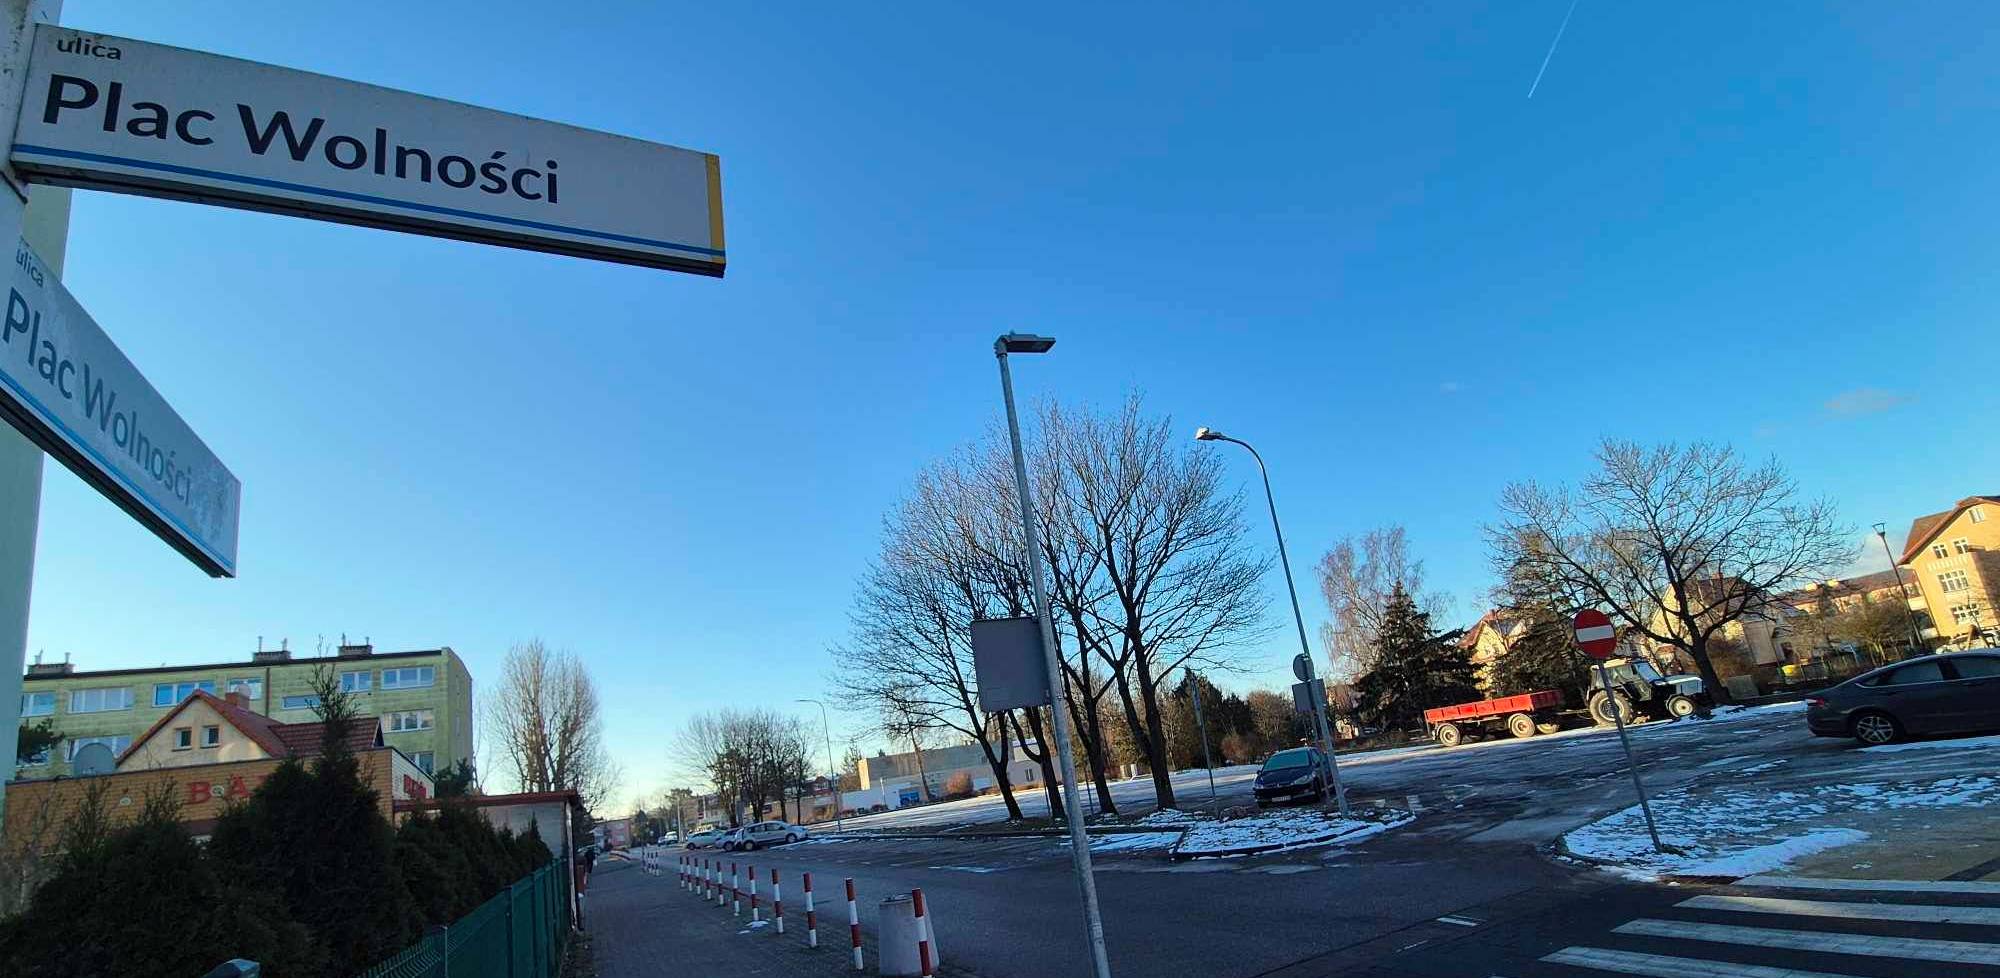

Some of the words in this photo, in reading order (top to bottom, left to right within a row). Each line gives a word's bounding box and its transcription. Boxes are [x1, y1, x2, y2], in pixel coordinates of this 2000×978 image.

[56, 37, 122, 61] ulica
[42, 73, 216, 146] Plac
[236, 103, 560, 204] Wolności
[15, 247, 44, 288] ulica
[2, 286, 76, 400] Plac
[83, 363, 193, 504] Wolności
